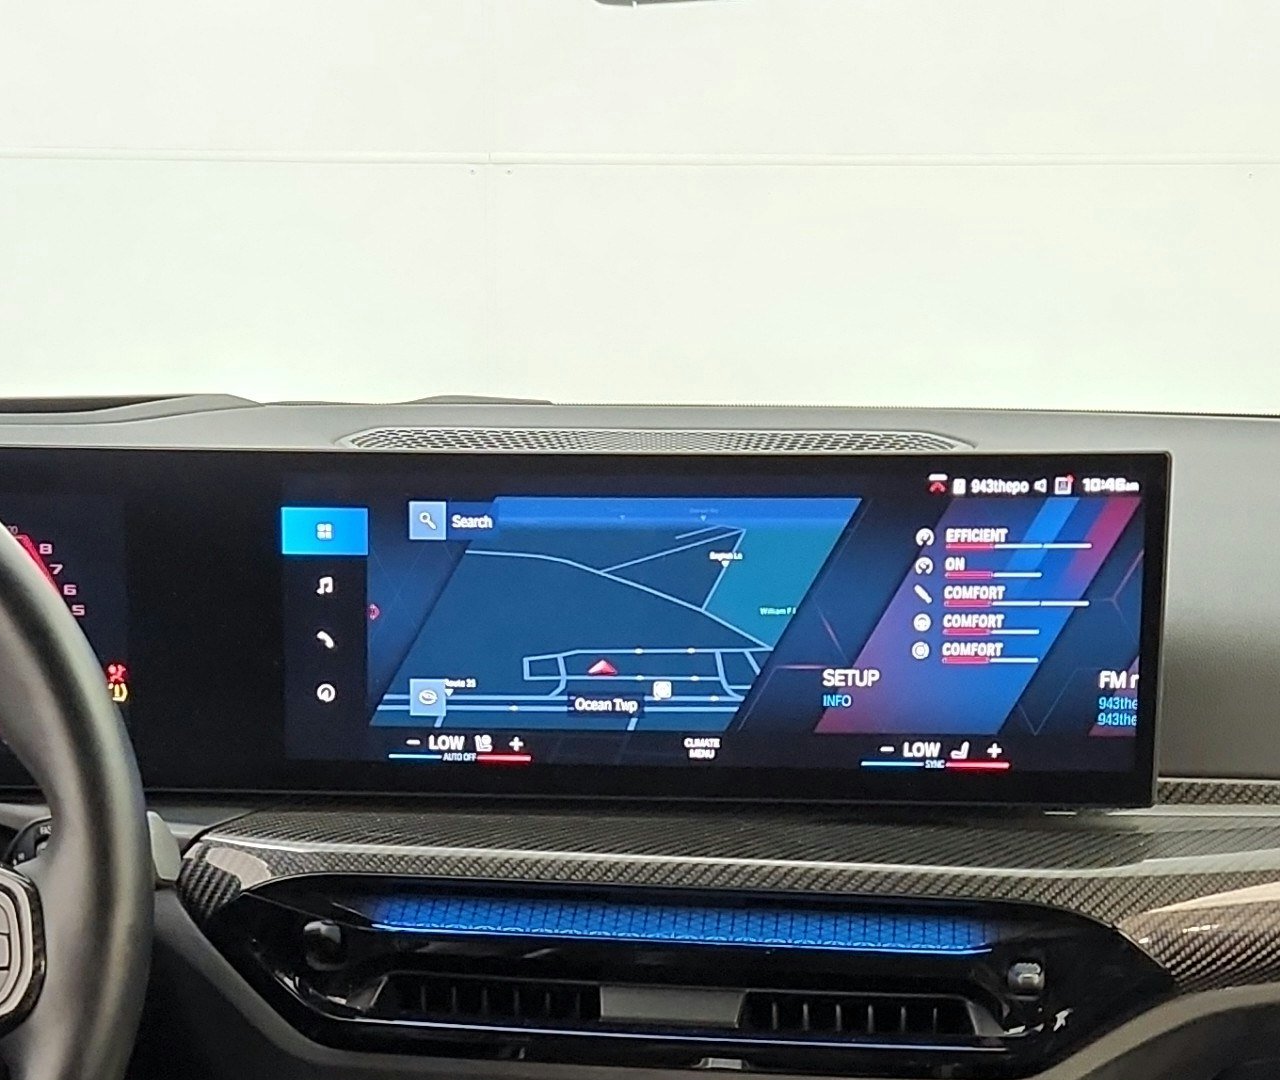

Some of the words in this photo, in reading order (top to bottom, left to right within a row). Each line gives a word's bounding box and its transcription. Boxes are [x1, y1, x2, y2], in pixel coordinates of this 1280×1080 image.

[451, 515, 494, 530] Search
[945, 528, 1009, 543] EFFICIENT
[39, 543, 53, 555] 8
[49, 563, 63, 575] 7
[945, 557, 965, 571] ON
[63, 584, 77, 596] 6
[944, 585, 1006, 600] COMFORT
[72, 604, 85, 616] 5
[942, 614, 1005, 628] COMFORT
[941, 642, 1003, 657] COMFORT
[822, 669, 880, 688] SETUP
[1099, 670, 1129, 689] FM
[574, 698, 613, 712] Ocean
[614, 699, 639, 714] Twp
[823, 694, 852, 708] INFO
[428, 734, 466, 751] LOW
[683, 738, 720, 749] CLIMATE
[903, 742, 941, 757] LOW
[443, 752, 462, 762] AUTO
[463, 752, 477, 762] OFF
[689, 749, 716, 759] MENU
[924, 760, 946, 769] SYNC
